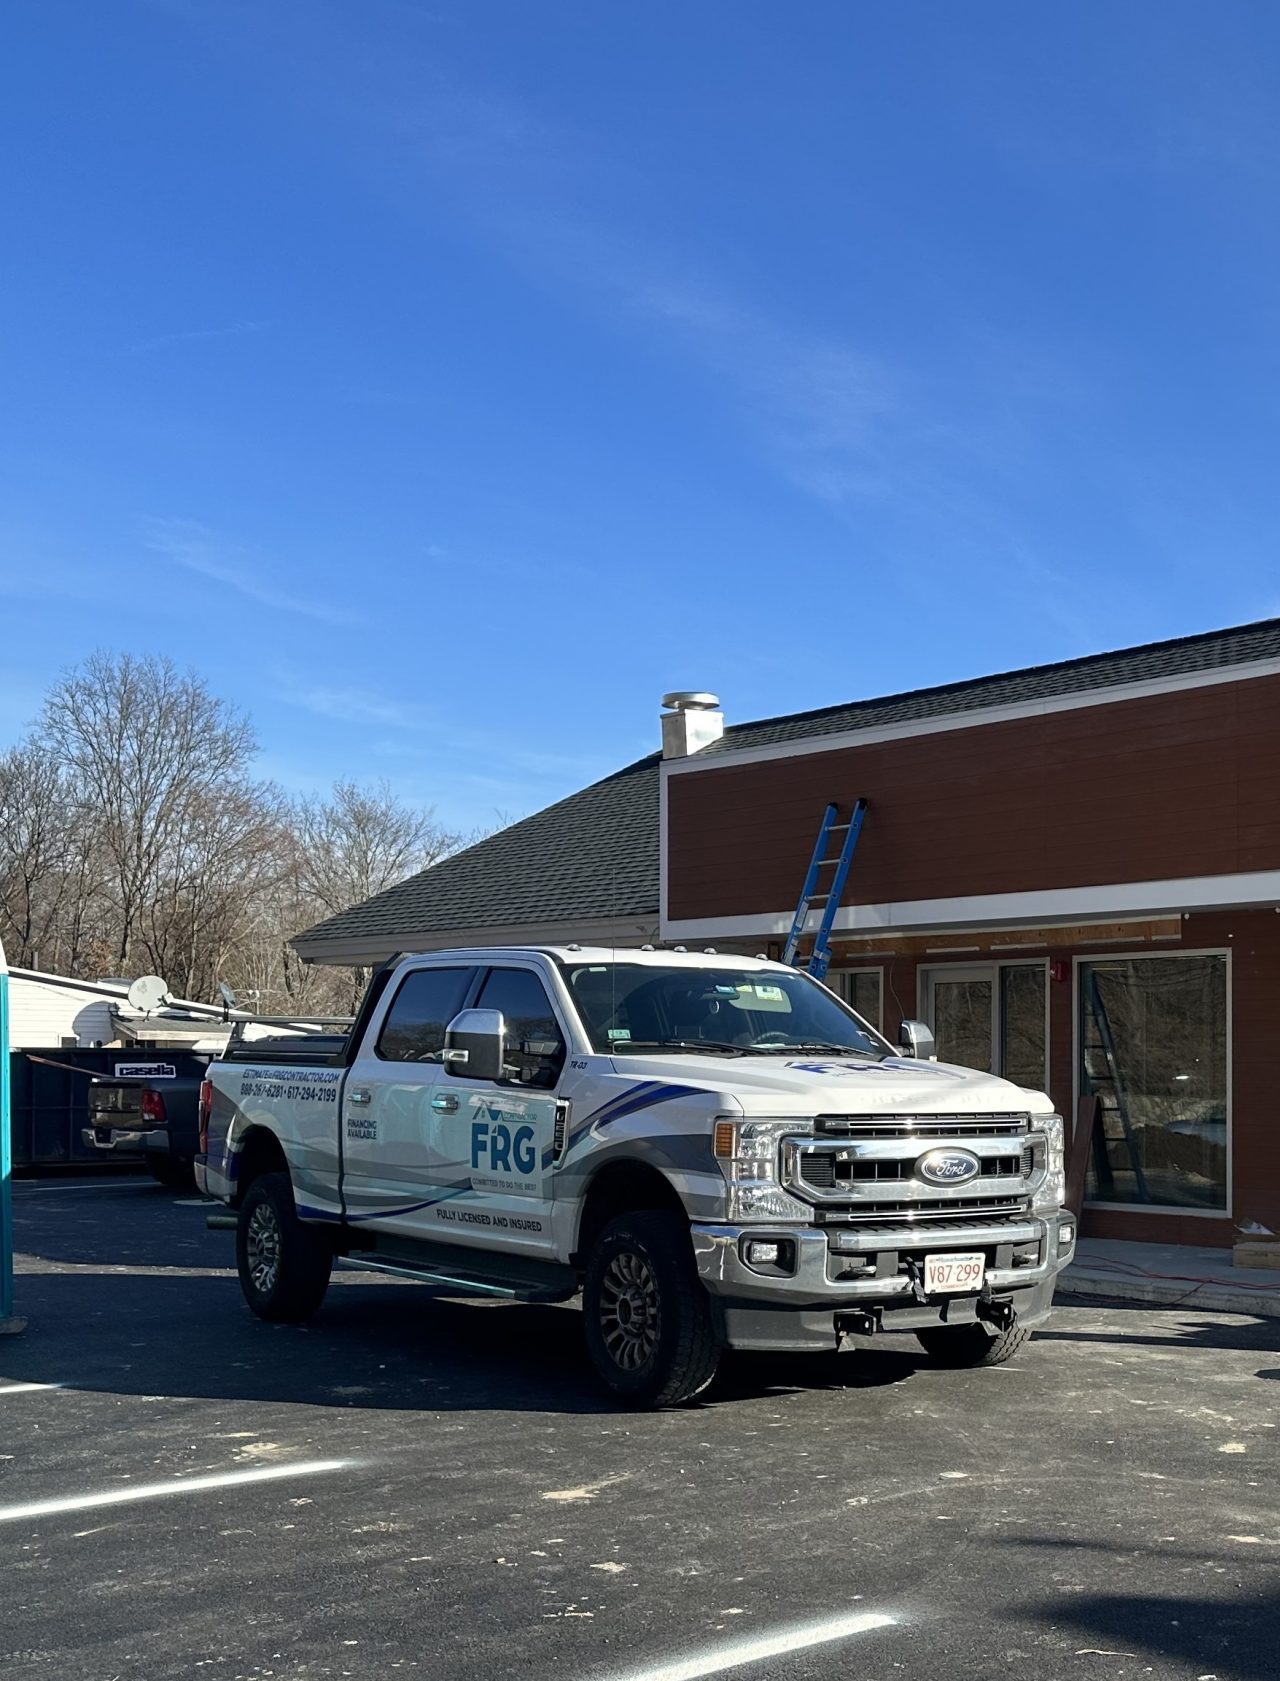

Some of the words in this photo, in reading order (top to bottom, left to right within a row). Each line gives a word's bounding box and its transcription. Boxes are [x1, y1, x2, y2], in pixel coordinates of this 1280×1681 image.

[119, 1064, 175, 1076] casella
[347, 1118, 377, 1129] FINANCING
[347, 1128, 377, 1140] AVAILABLE
[471, 1122, 536, 1175] FRG
[936, 1159, 967, 1176] Ford
[436, 1208, 456, 1220] FULLY
[457, 1211, 490, 1226] LICENSED
[492, 1215, 508, 1228] AND
[509, 1217, 542, 1232] INSURED
